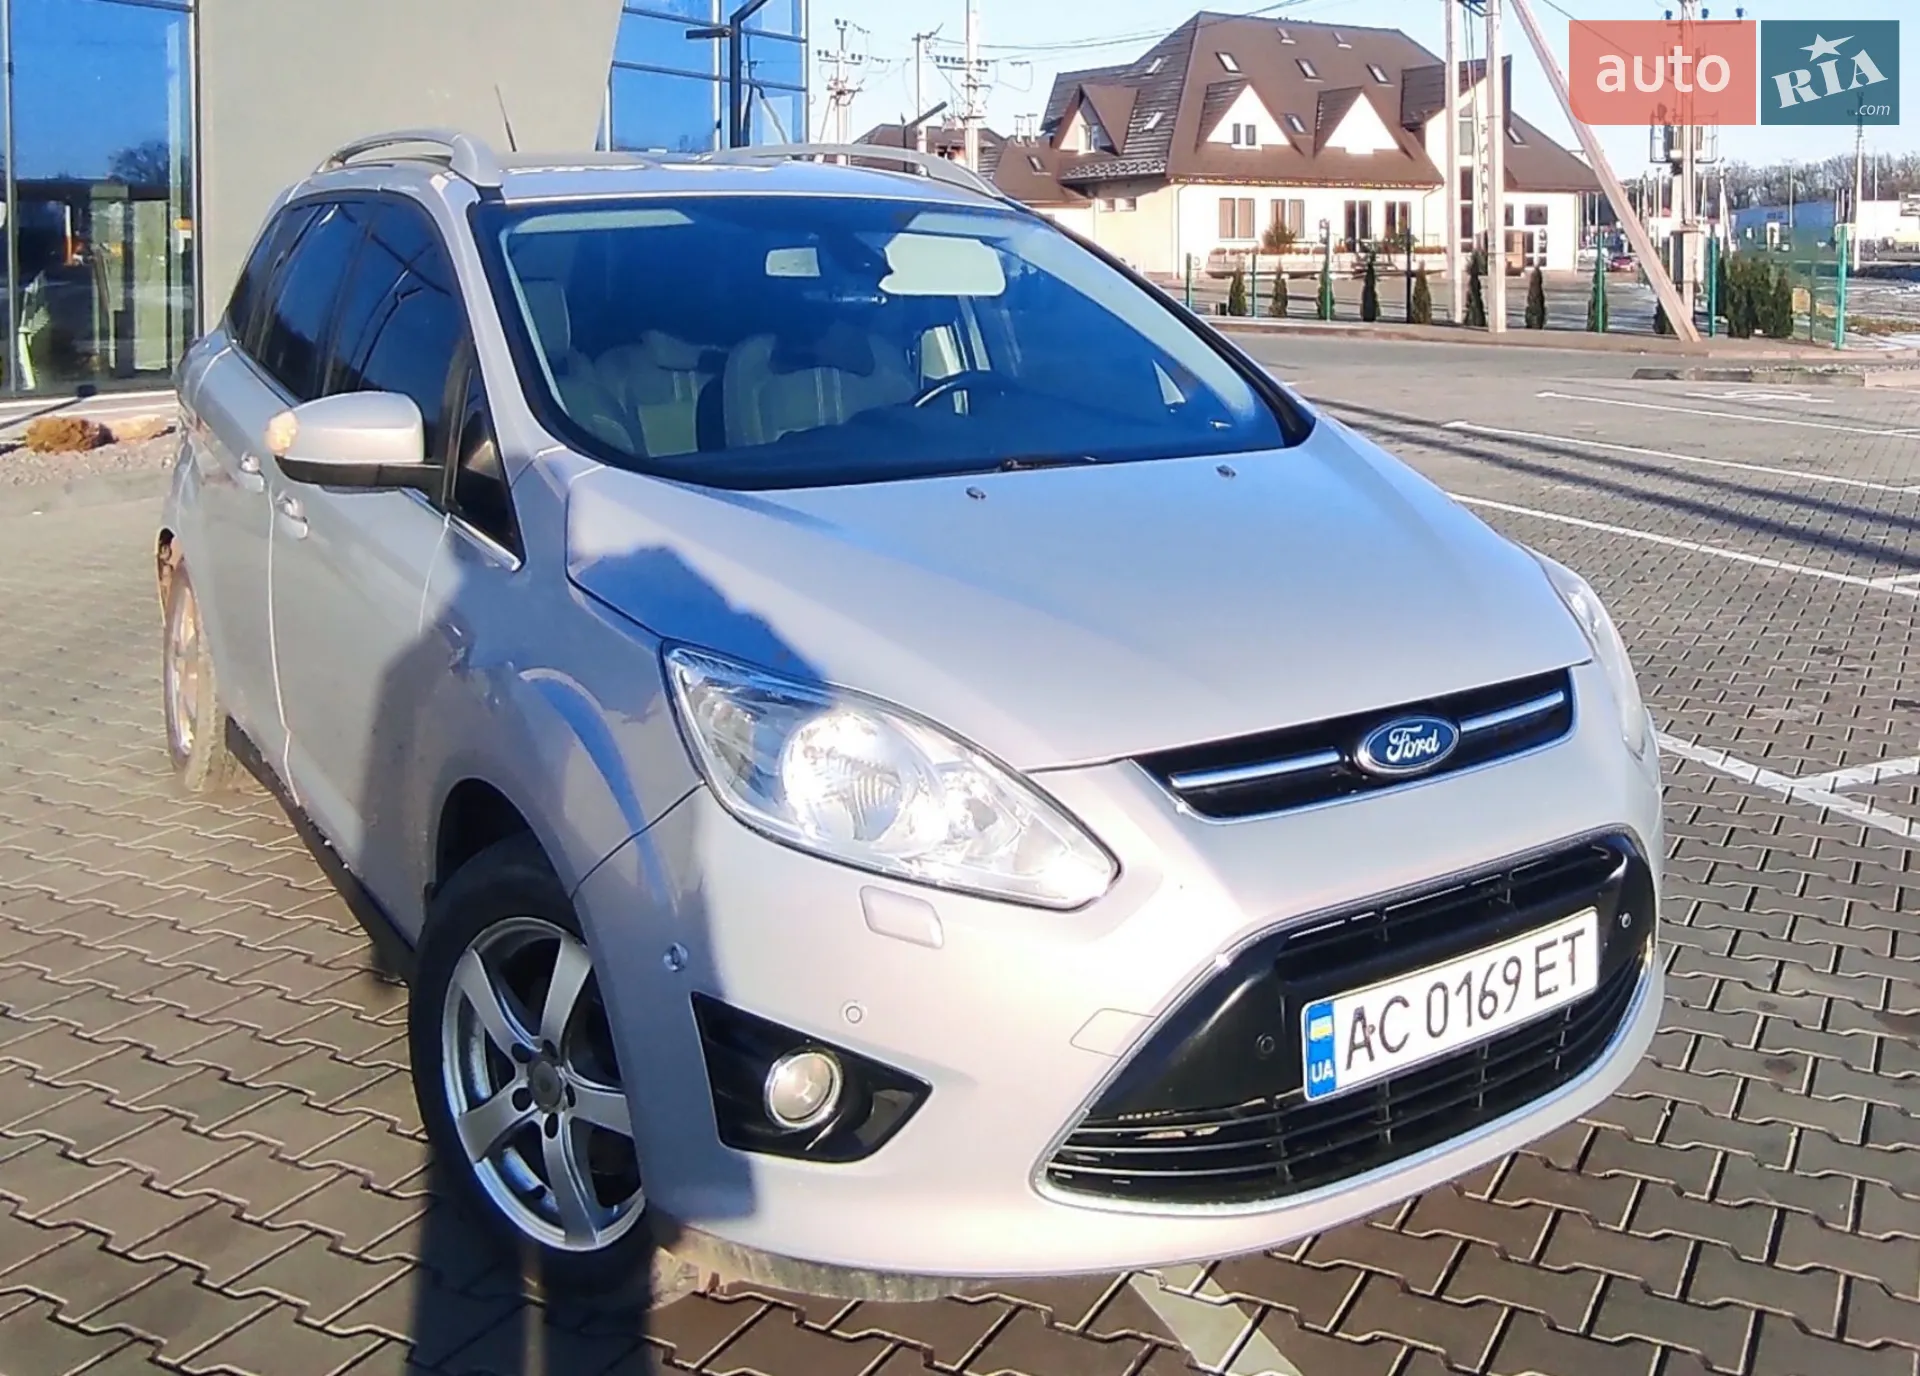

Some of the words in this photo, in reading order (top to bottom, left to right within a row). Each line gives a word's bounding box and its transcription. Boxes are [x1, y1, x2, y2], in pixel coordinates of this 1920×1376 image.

[1386, 724, 1440, 762] Ford
[1345, 995, 1410, 1071] AC
[1426, 955, 1522, 1038] 0169
[1535, 928, 1585, 1000] ET
[1310, 1060, 1334, 1083] UA
